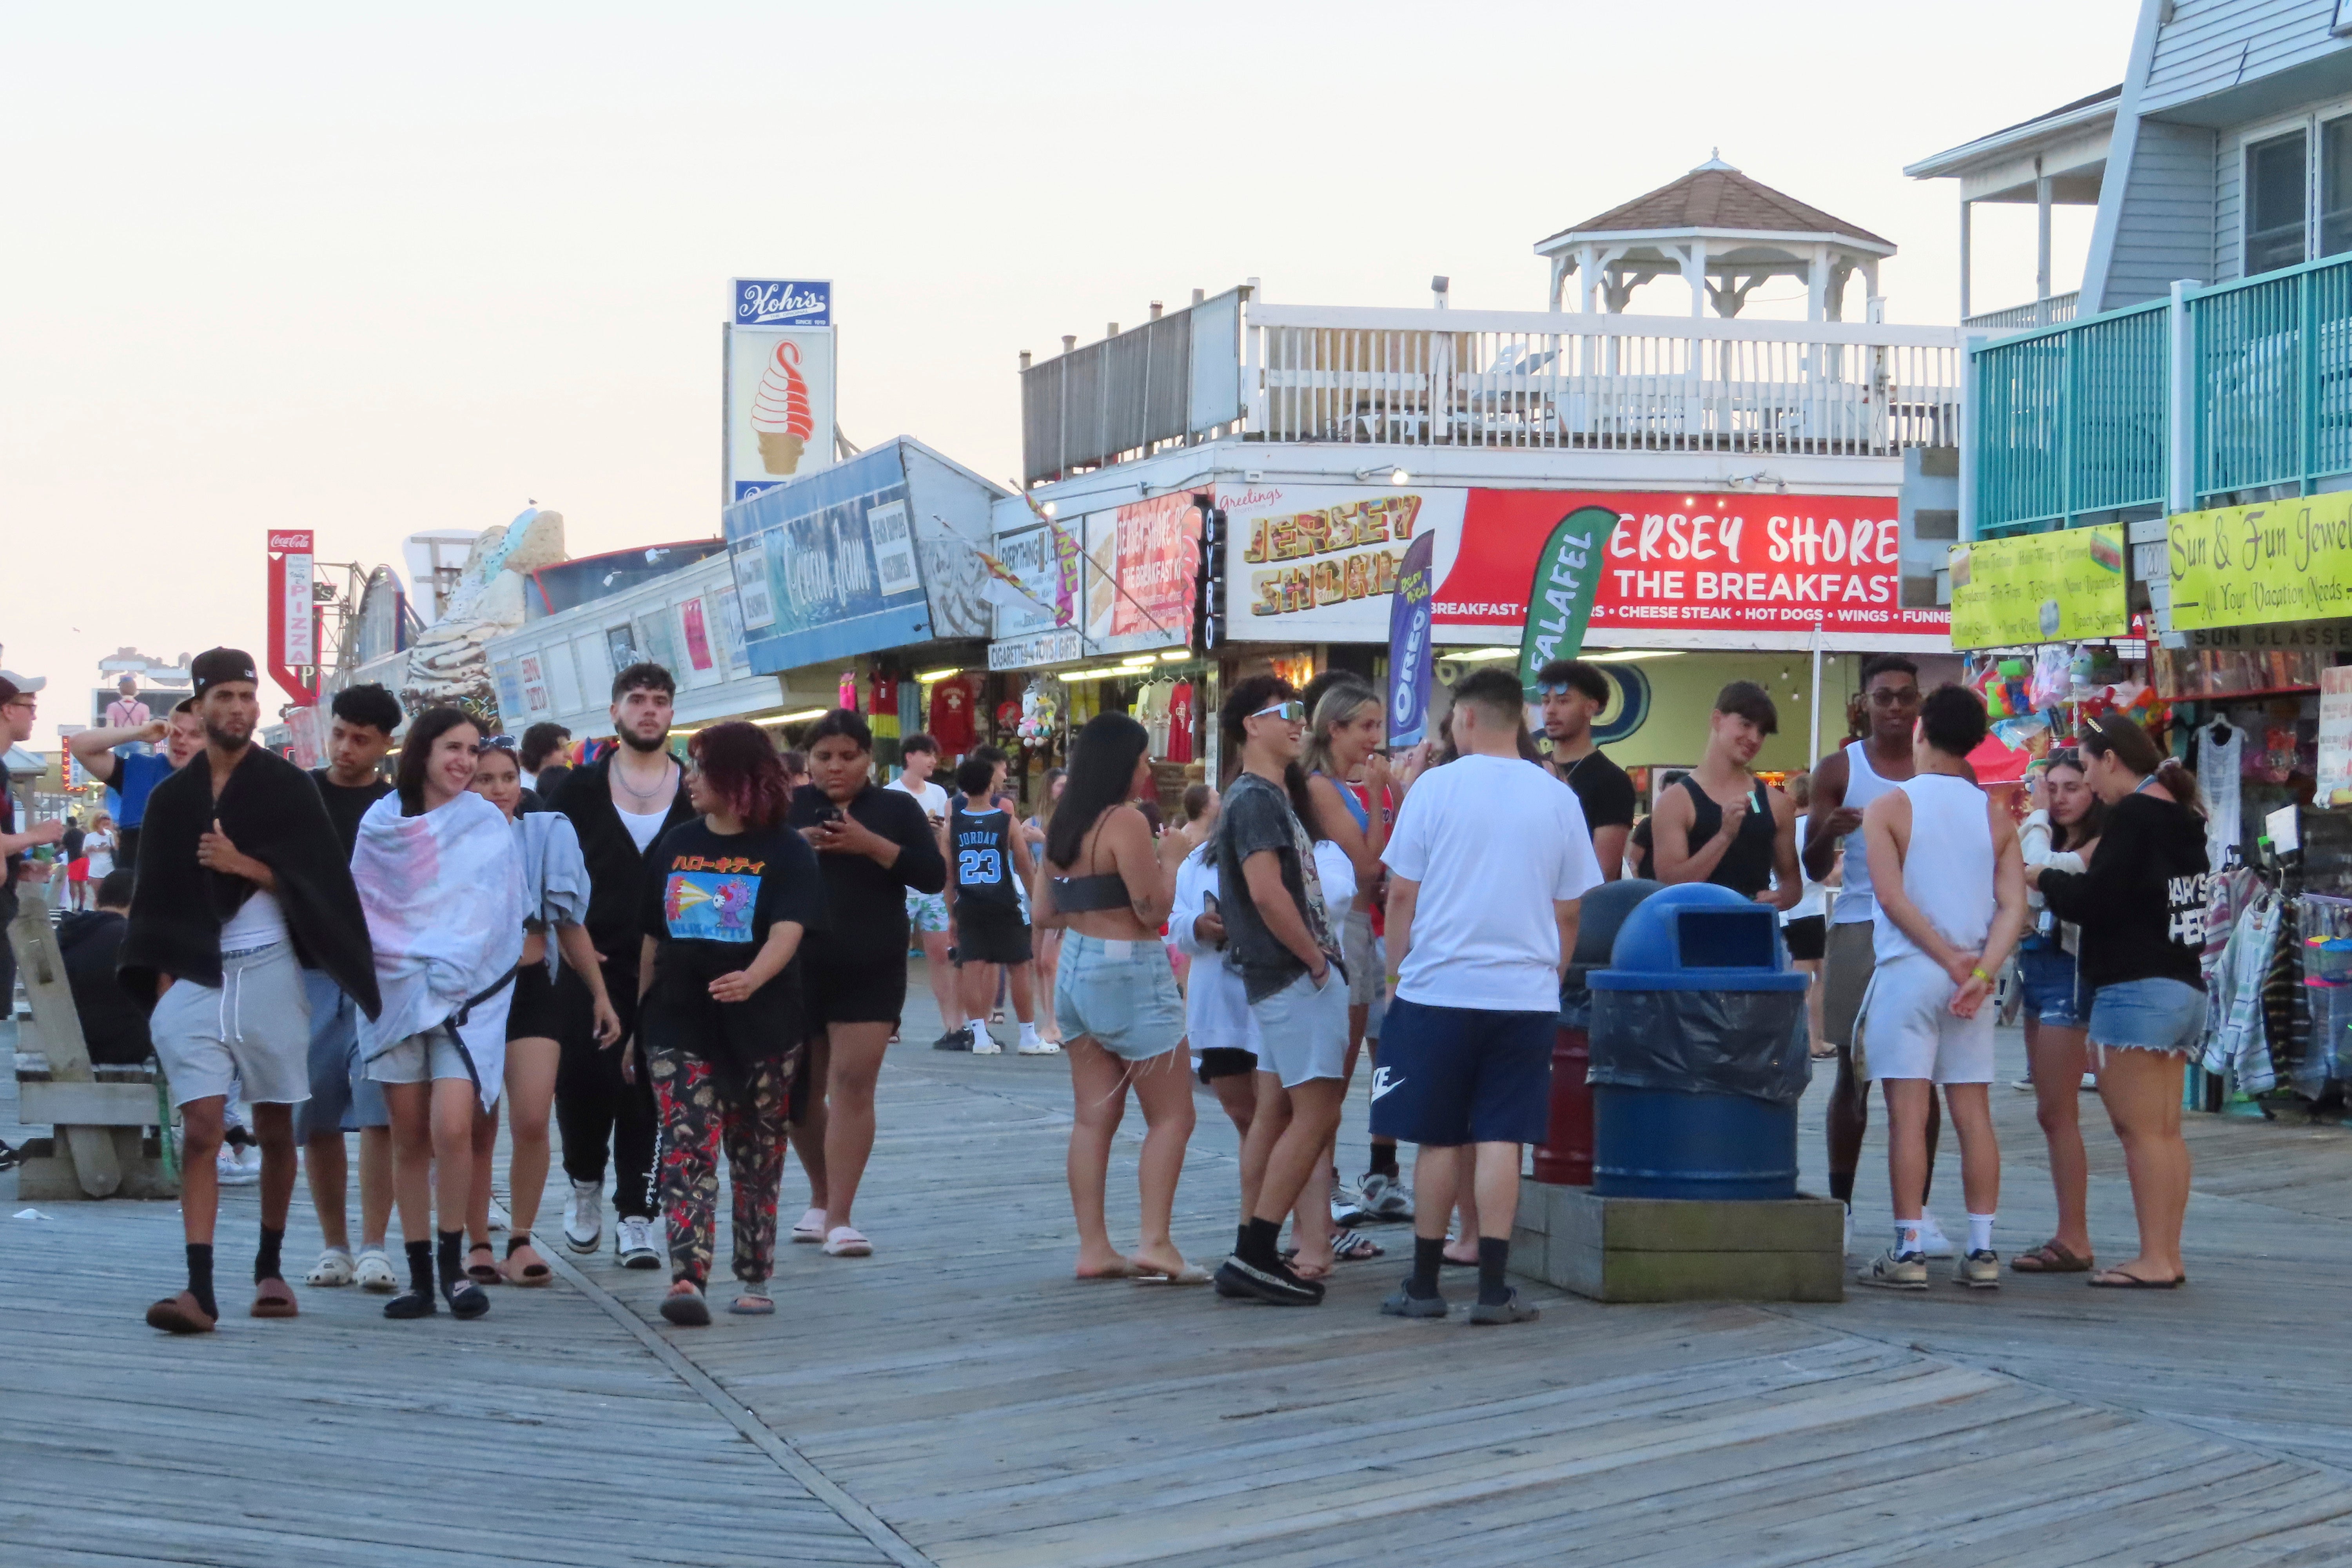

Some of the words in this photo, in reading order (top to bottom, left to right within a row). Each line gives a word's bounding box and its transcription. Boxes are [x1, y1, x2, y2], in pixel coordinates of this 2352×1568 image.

[739, 283, 816, 317] Kohr's
[1220, 488, 1283, 513] Greetings
[270, 534, 310, 548] Coca-Cola
[1118, 516, 1145, 556] JERSEY
[1147, 510, 1171, 551] SHORE
[1244, 494, 1422, 563] JERSEY
[1610, 512, 1743, 564] ERSEY
[1767, 515, 1898, 566] SHORE
[2170, 524, 2206, 581] Sun
[2213, 515, 2232, 570] &
[2242, 510, 2286, 572] Fun
[1123, 568, 1134, 589] THE
[1136, 559, 1173, 587] BREAKFAST
[1205, 508, 1214, 651] GYRO
[1251, 546, 1408, 616] SHORE
[1613, 570, 1684, 599] THE
[1697, 571, 1898, 603] BREAKFAS
[1431, 602, 1519, 615] BREAKFAST
[1530, 532, 1592, 672] FALAFEL
[2220, 583, 2247, 611] Your
[2252, 582, 2303, 612] Vacation
[2308, 575, 2342, 612] Needs
[290, 584, 307, 663] PIZZA
[1619, 605, 1678, 619] CHEESE
[1681, 606, 1732, 621] STEAK
[1745, 607, 1778, 621] HOT
[1781, 608, 1824, 622] DOGS
[1837, 609, 1889, 623] WINGS
[1903, 610, 1951, 624] FUNNE
[2195, 628, 2241, 646] SUN
[958, 831, 999, 847] JORDAN
[672, 855, 766, 874] ハローキティ
[958, 849, 1002, 885] 23
